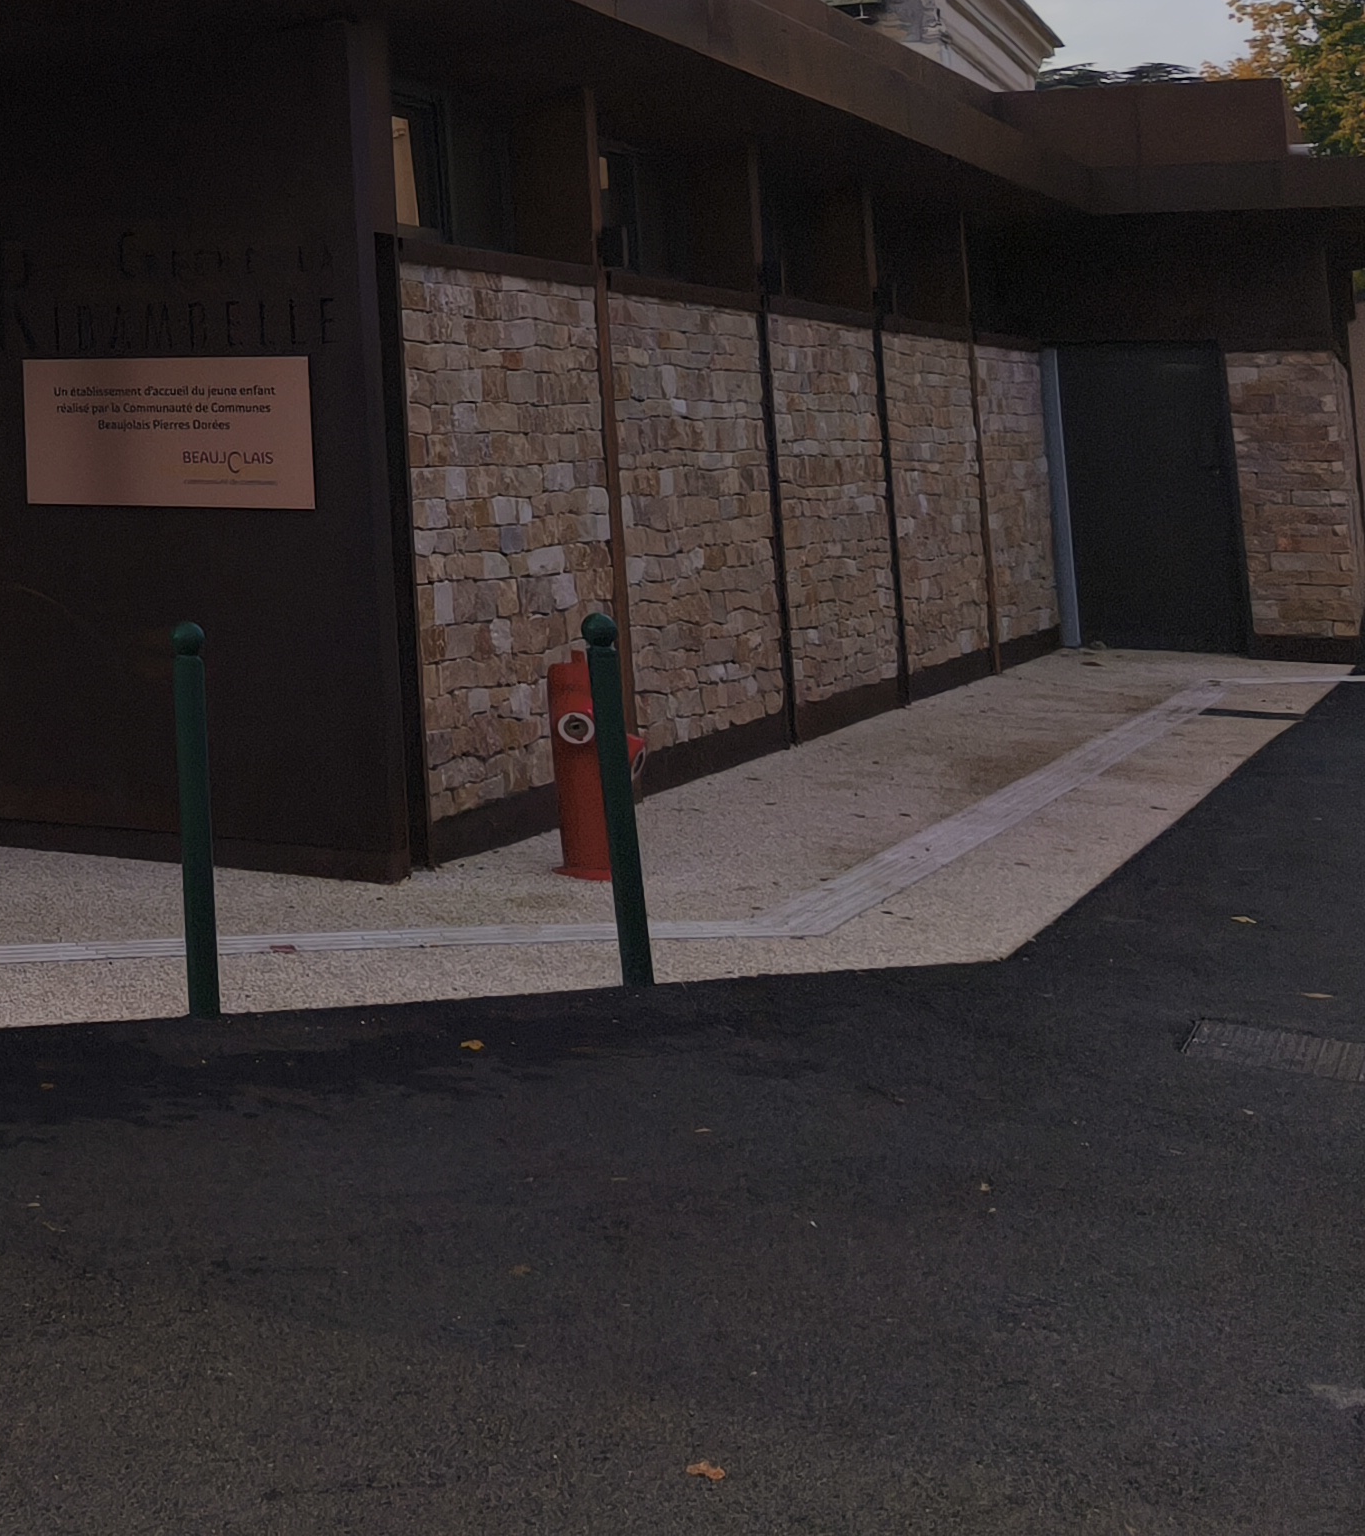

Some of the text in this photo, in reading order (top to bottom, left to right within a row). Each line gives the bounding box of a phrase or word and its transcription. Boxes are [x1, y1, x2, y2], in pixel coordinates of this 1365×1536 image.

[53, 384, 276, 398] Un établissement d'accueil du jeune enfant
[56, 402, 271, 415] réalisé par la Communauté de Communes
[98, 419, 230, 432] Beaujolais Pierres Dorées
